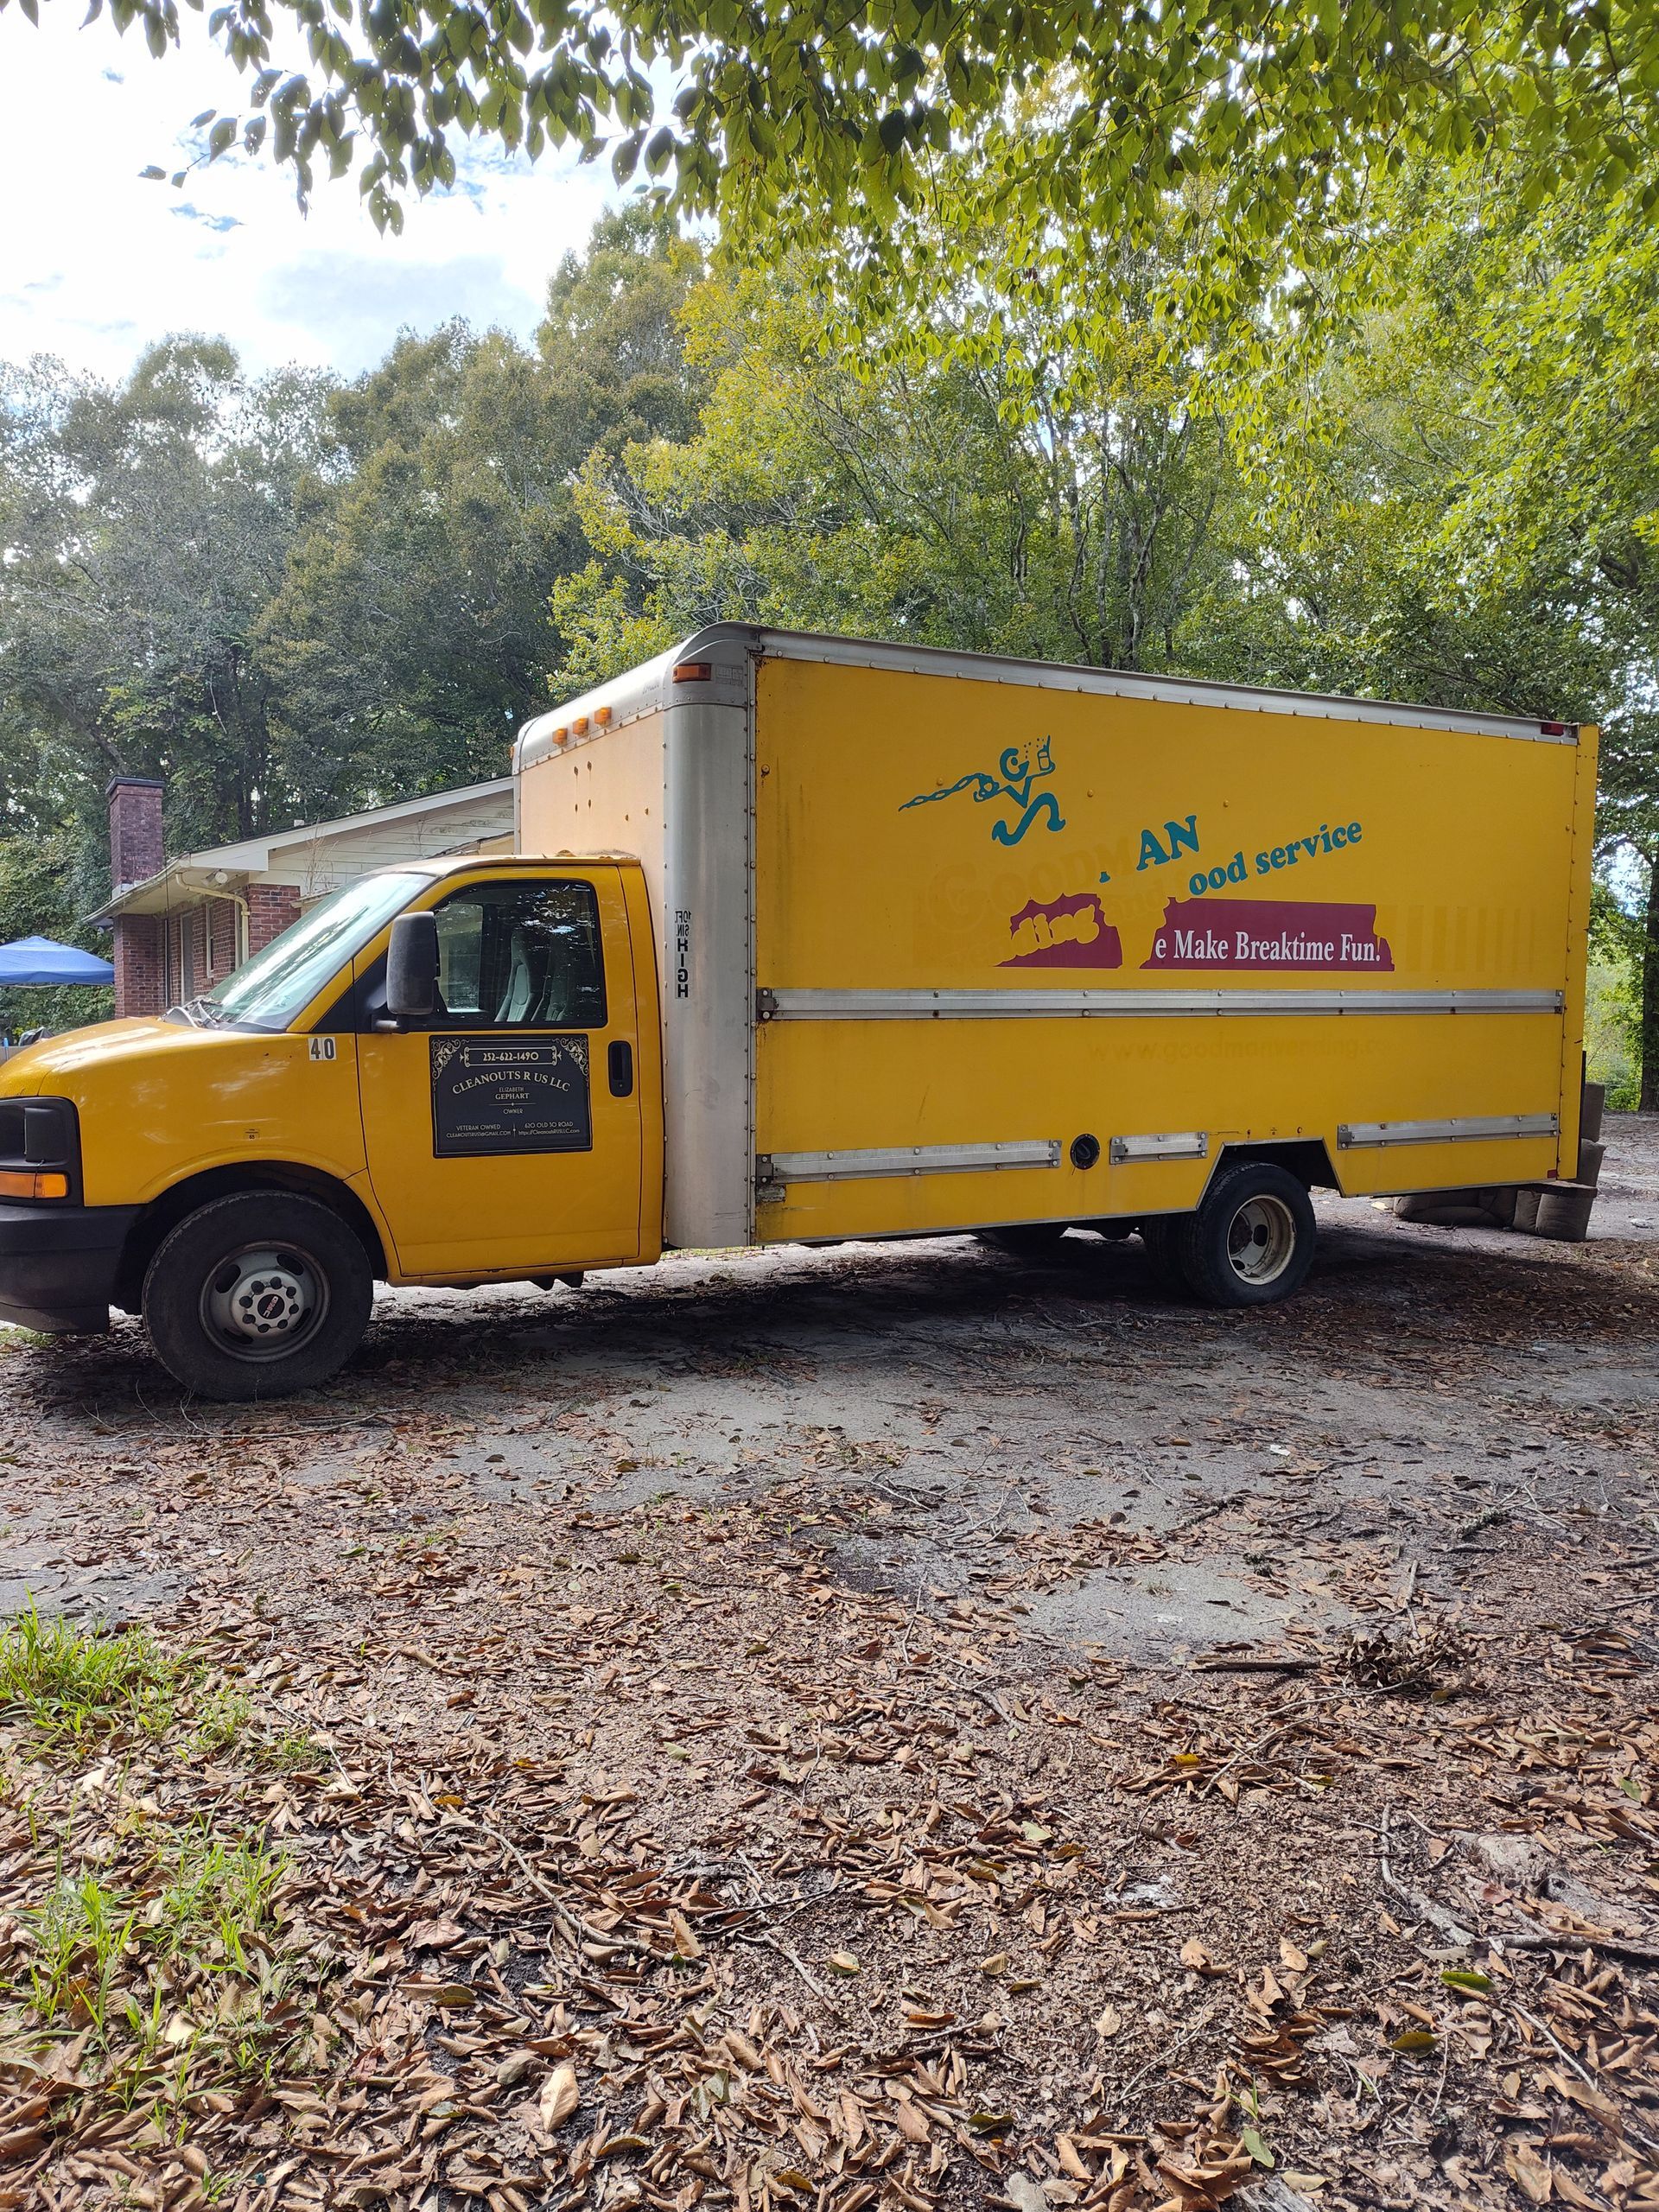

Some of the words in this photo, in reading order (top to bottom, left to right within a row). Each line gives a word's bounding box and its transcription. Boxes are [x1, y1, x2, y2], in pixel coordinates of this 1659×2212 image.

[1189, 852, 1248, 895] ood
[1255, 820, 1363, 875] service
[1154, 938, 1168, 962] e
[1173, 929, 1229, 961] Make
[1236, 930, 1337, 963] Breaktime
[1340, 933, 1382, 963] Fun.
[311, 1038, 334, 1059] 40
[482, 1051, 539, 1062] 252-622-1490
[1088, 1031, 1402, 1065] www.goodmanvending.c
[451, 1070, 521, 1096] CLEANOUTS
[523, 1071, 531, 1081] R
[534, 1072, 548, 1084] US
[550, 1078, 571, 1092] LLC
[495, 1092, 530, 1101] GEPHART
